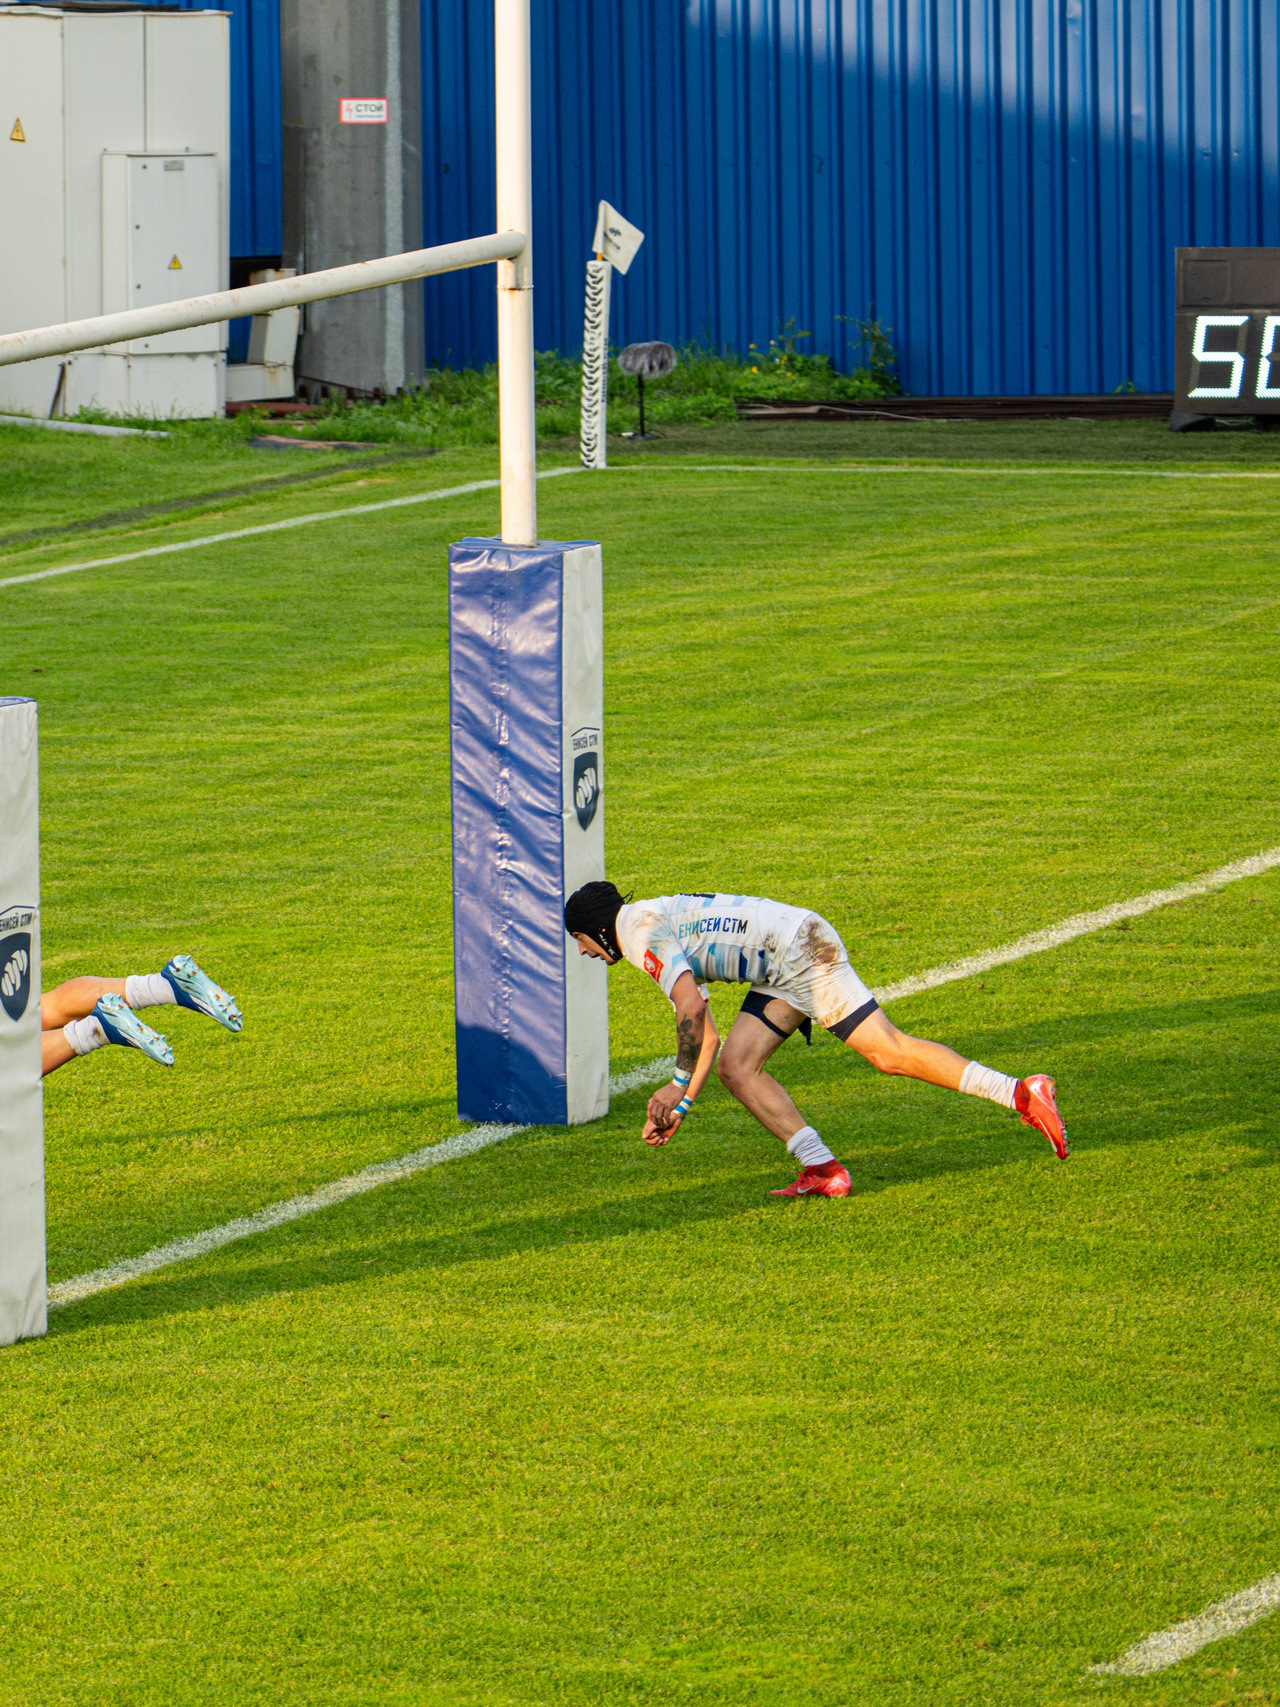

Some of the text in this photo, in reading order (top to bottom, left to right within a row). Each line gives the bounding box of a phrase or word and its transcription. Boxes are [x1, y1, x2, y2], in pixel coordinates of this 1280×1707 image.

[355, 102, 384, 113] СТОЙ
[20, 911, 33, 928] СТМ
[722, 917, 749, 935] СТМ
